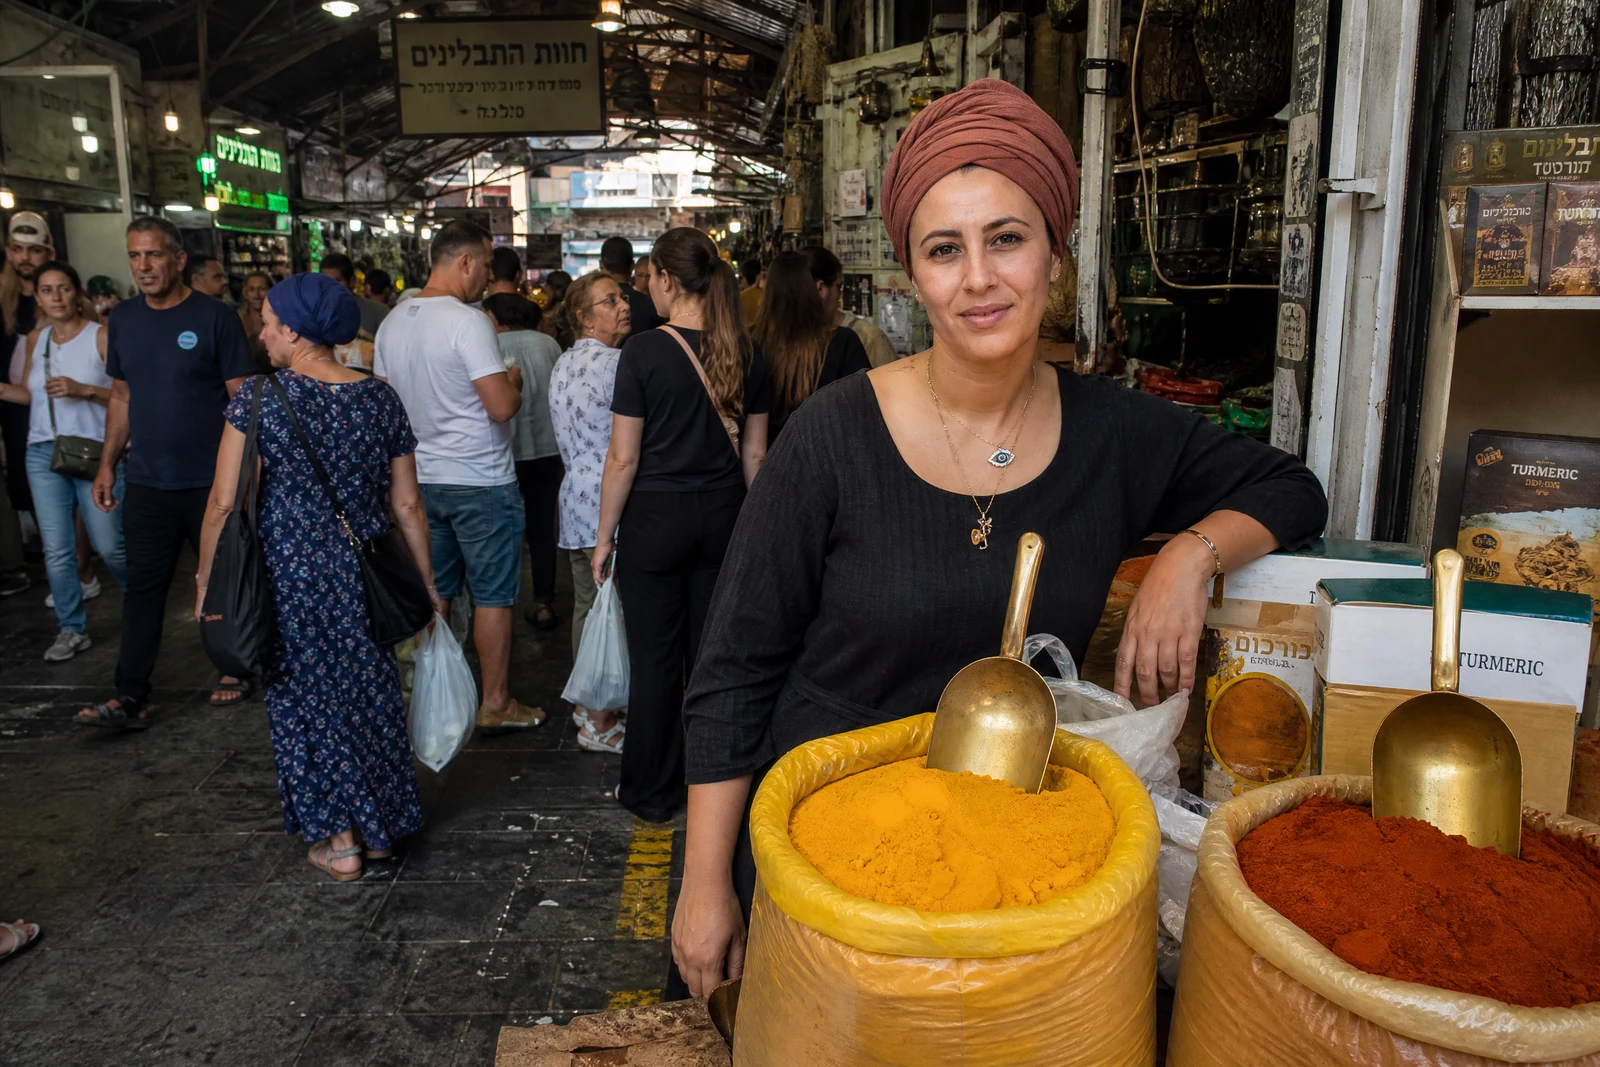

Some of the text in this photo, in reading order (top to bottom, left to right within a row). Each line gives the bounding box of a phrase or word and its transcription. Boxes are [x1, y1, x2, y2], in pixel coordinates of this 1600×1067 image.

[410, 38, 587, 67] חוות התבלינים
[1511, 463, 1579, 481] TURMERIC
[1235, 634, 1312, 661] כורכום
[1459, 651, 1544, 677] TURMERIC
